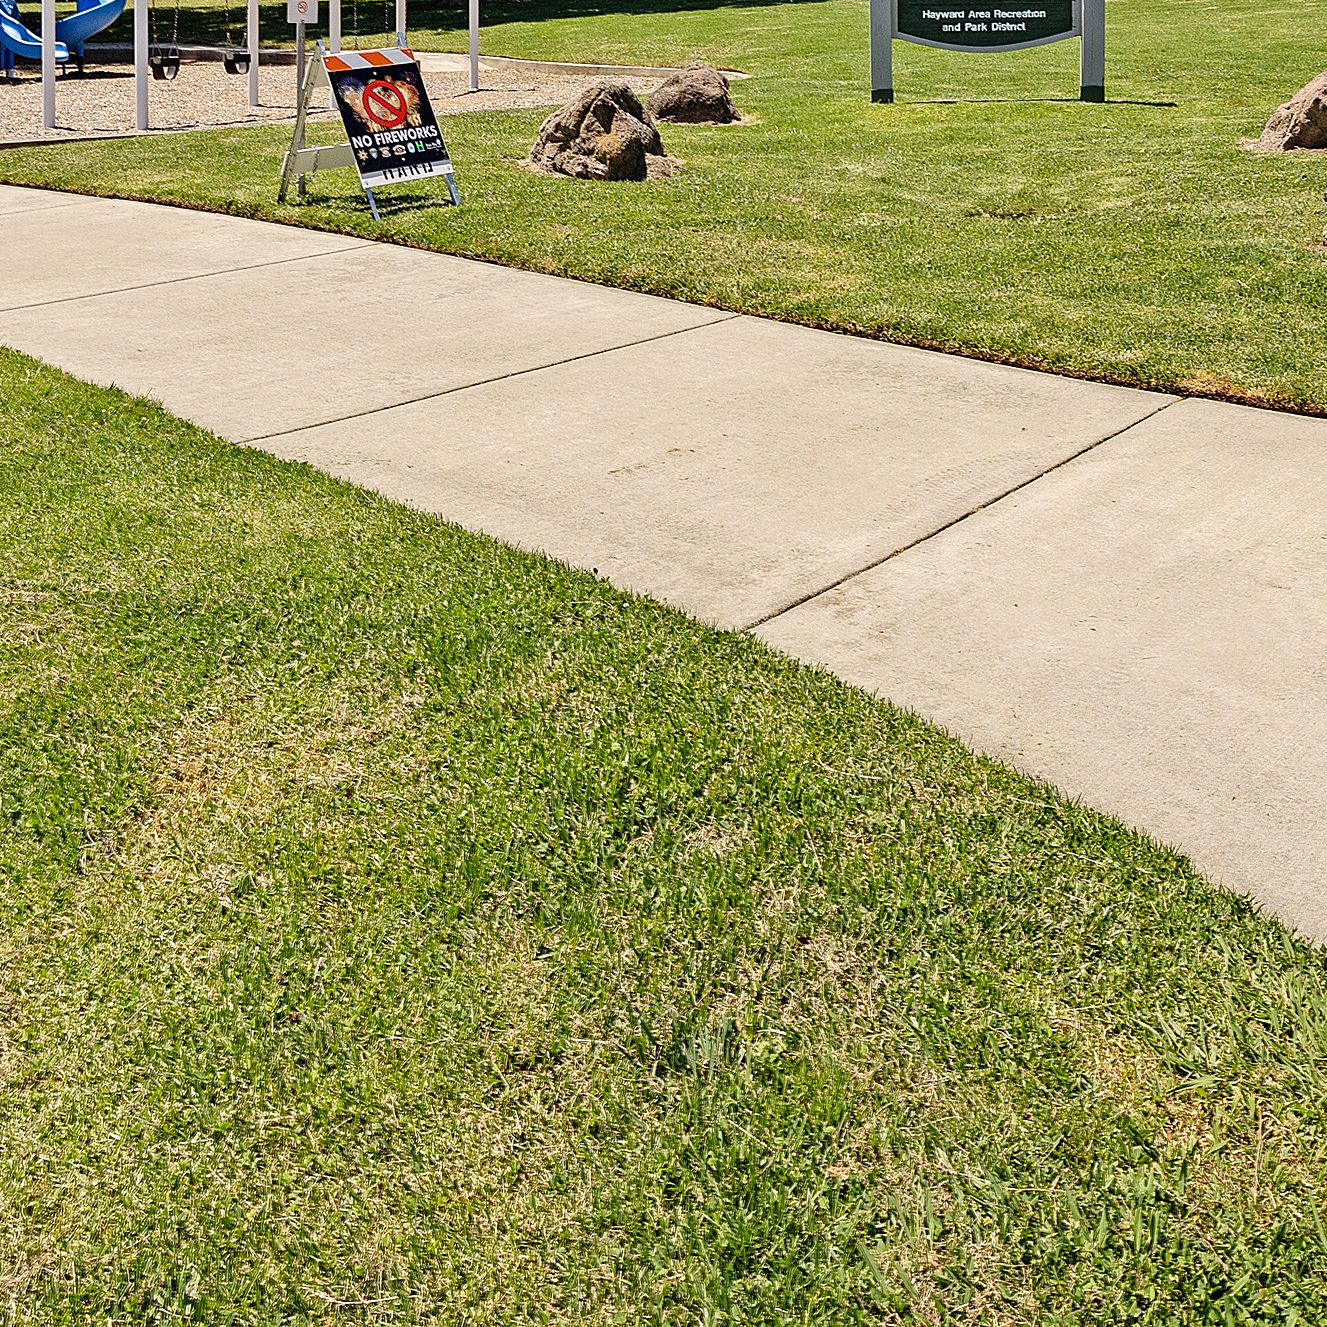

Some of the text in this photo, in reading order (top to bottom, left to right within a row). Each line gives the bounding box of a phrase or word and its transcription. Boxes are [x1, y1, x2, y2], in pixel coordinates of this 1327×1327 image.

[922, 9, 1046, 20] Hayward Area Recreation
[942, 22, 1026, 32] and Park District
[351, 135, 373, 149] NO
[374, 125, 438, 146] FIREWORKS
